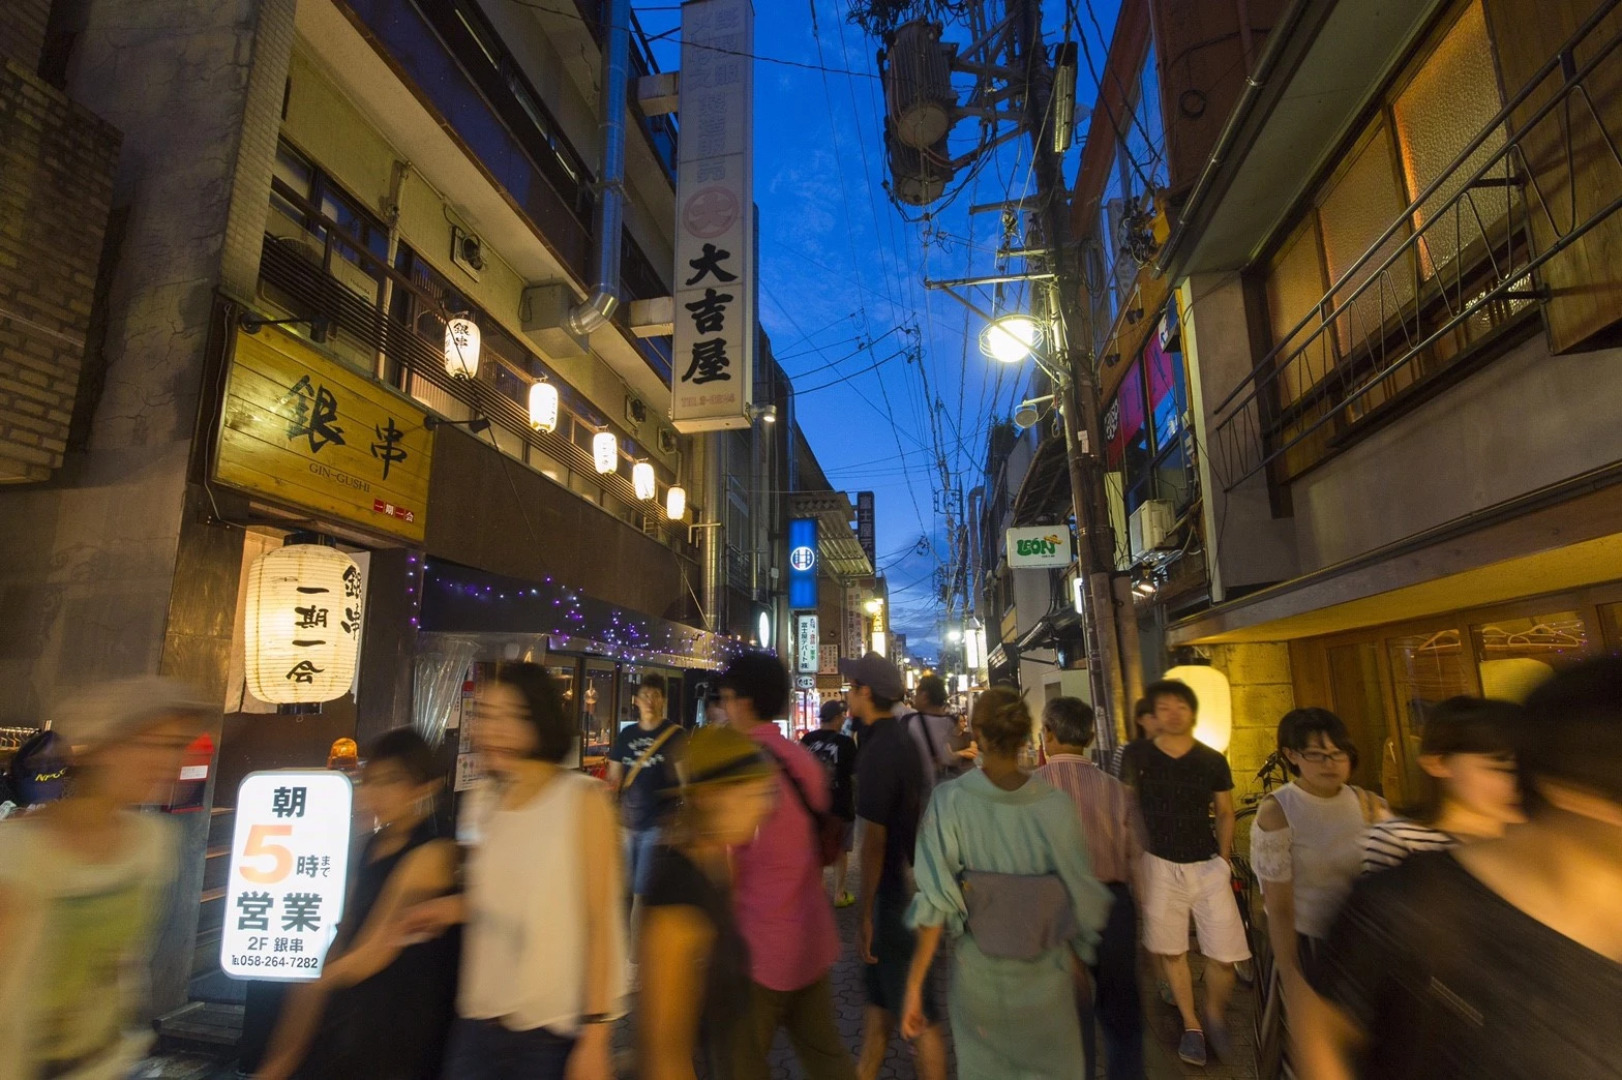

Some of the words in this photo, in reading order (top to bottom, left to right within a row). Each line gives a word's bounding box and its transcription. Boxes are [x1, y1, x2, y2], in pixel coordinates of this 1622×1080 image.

[681, 243, 739, 385] 大吉屋
[282, 374, 408, 482] 銀串
[309, 463, 371, 493] GIN-GUSHI
[374, 499, 415, 523] 一期一会
[286, 586, 330, 684] 一期一会
[272, 786, 307, 818] 朝
[237, 890, 323, 932] 営業
[247, 936, 268, 951] 2F
[273, 937, 304, 953] 銀串
